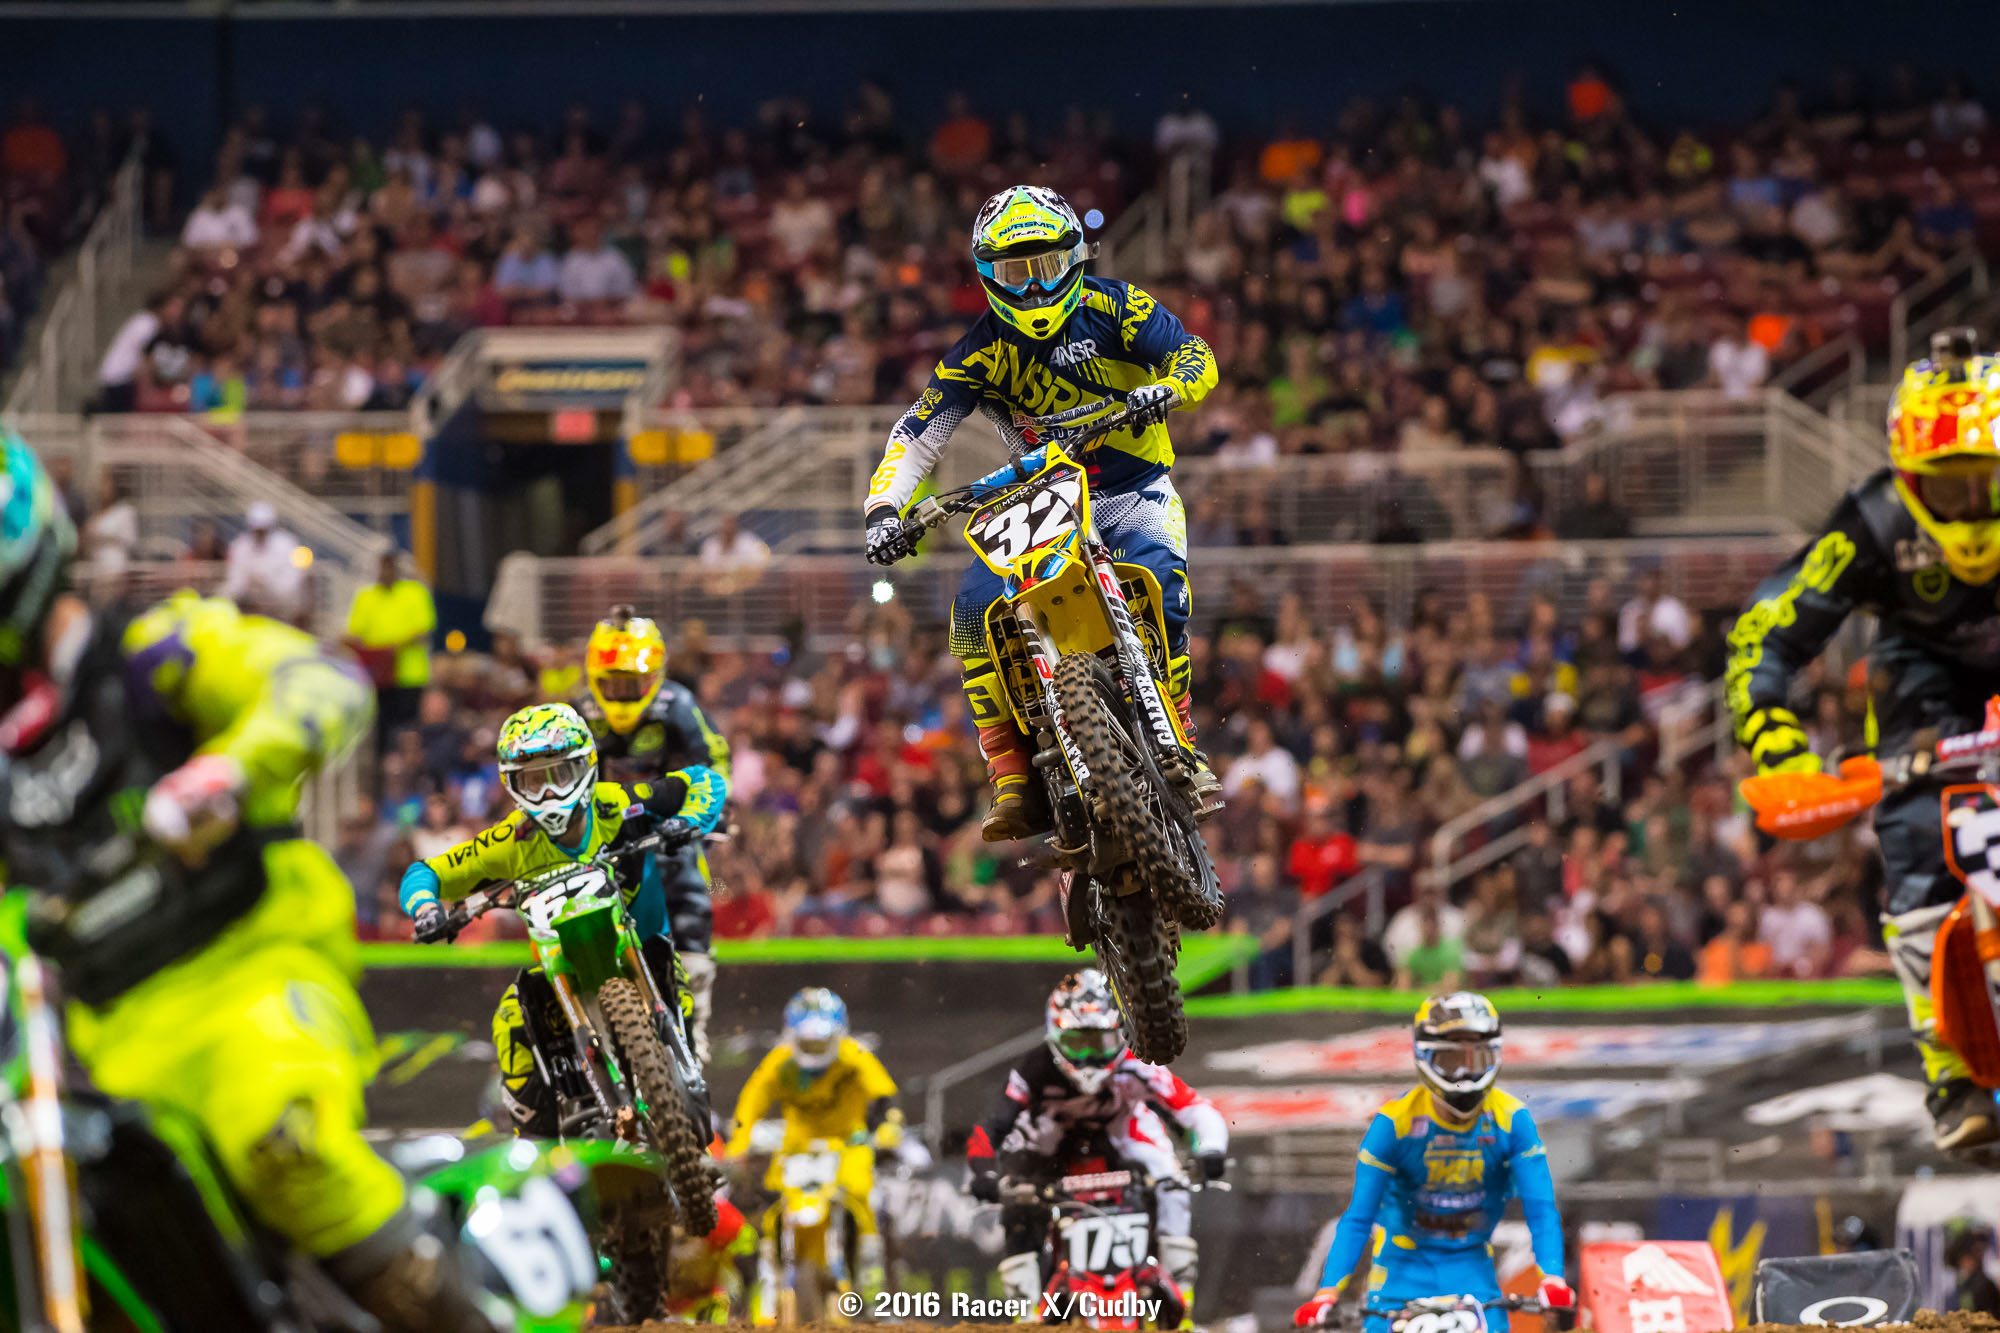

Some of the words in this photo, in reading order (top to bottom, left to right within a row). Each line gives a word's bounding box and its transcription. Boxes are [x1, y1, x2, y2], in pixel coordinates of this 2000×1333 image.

[962, 338, 1081, 416] ANSR
[1050, 339, 1100, 367] ANSR
[1040, 411, 1117, 443] SUZU
[984, 481, 1081, 568] 32
[1136, 675, 1176, 746] GALFER
[1053, 708, 1091, 786] GALFER
[1061, 1212, 1150, 1273] 175
